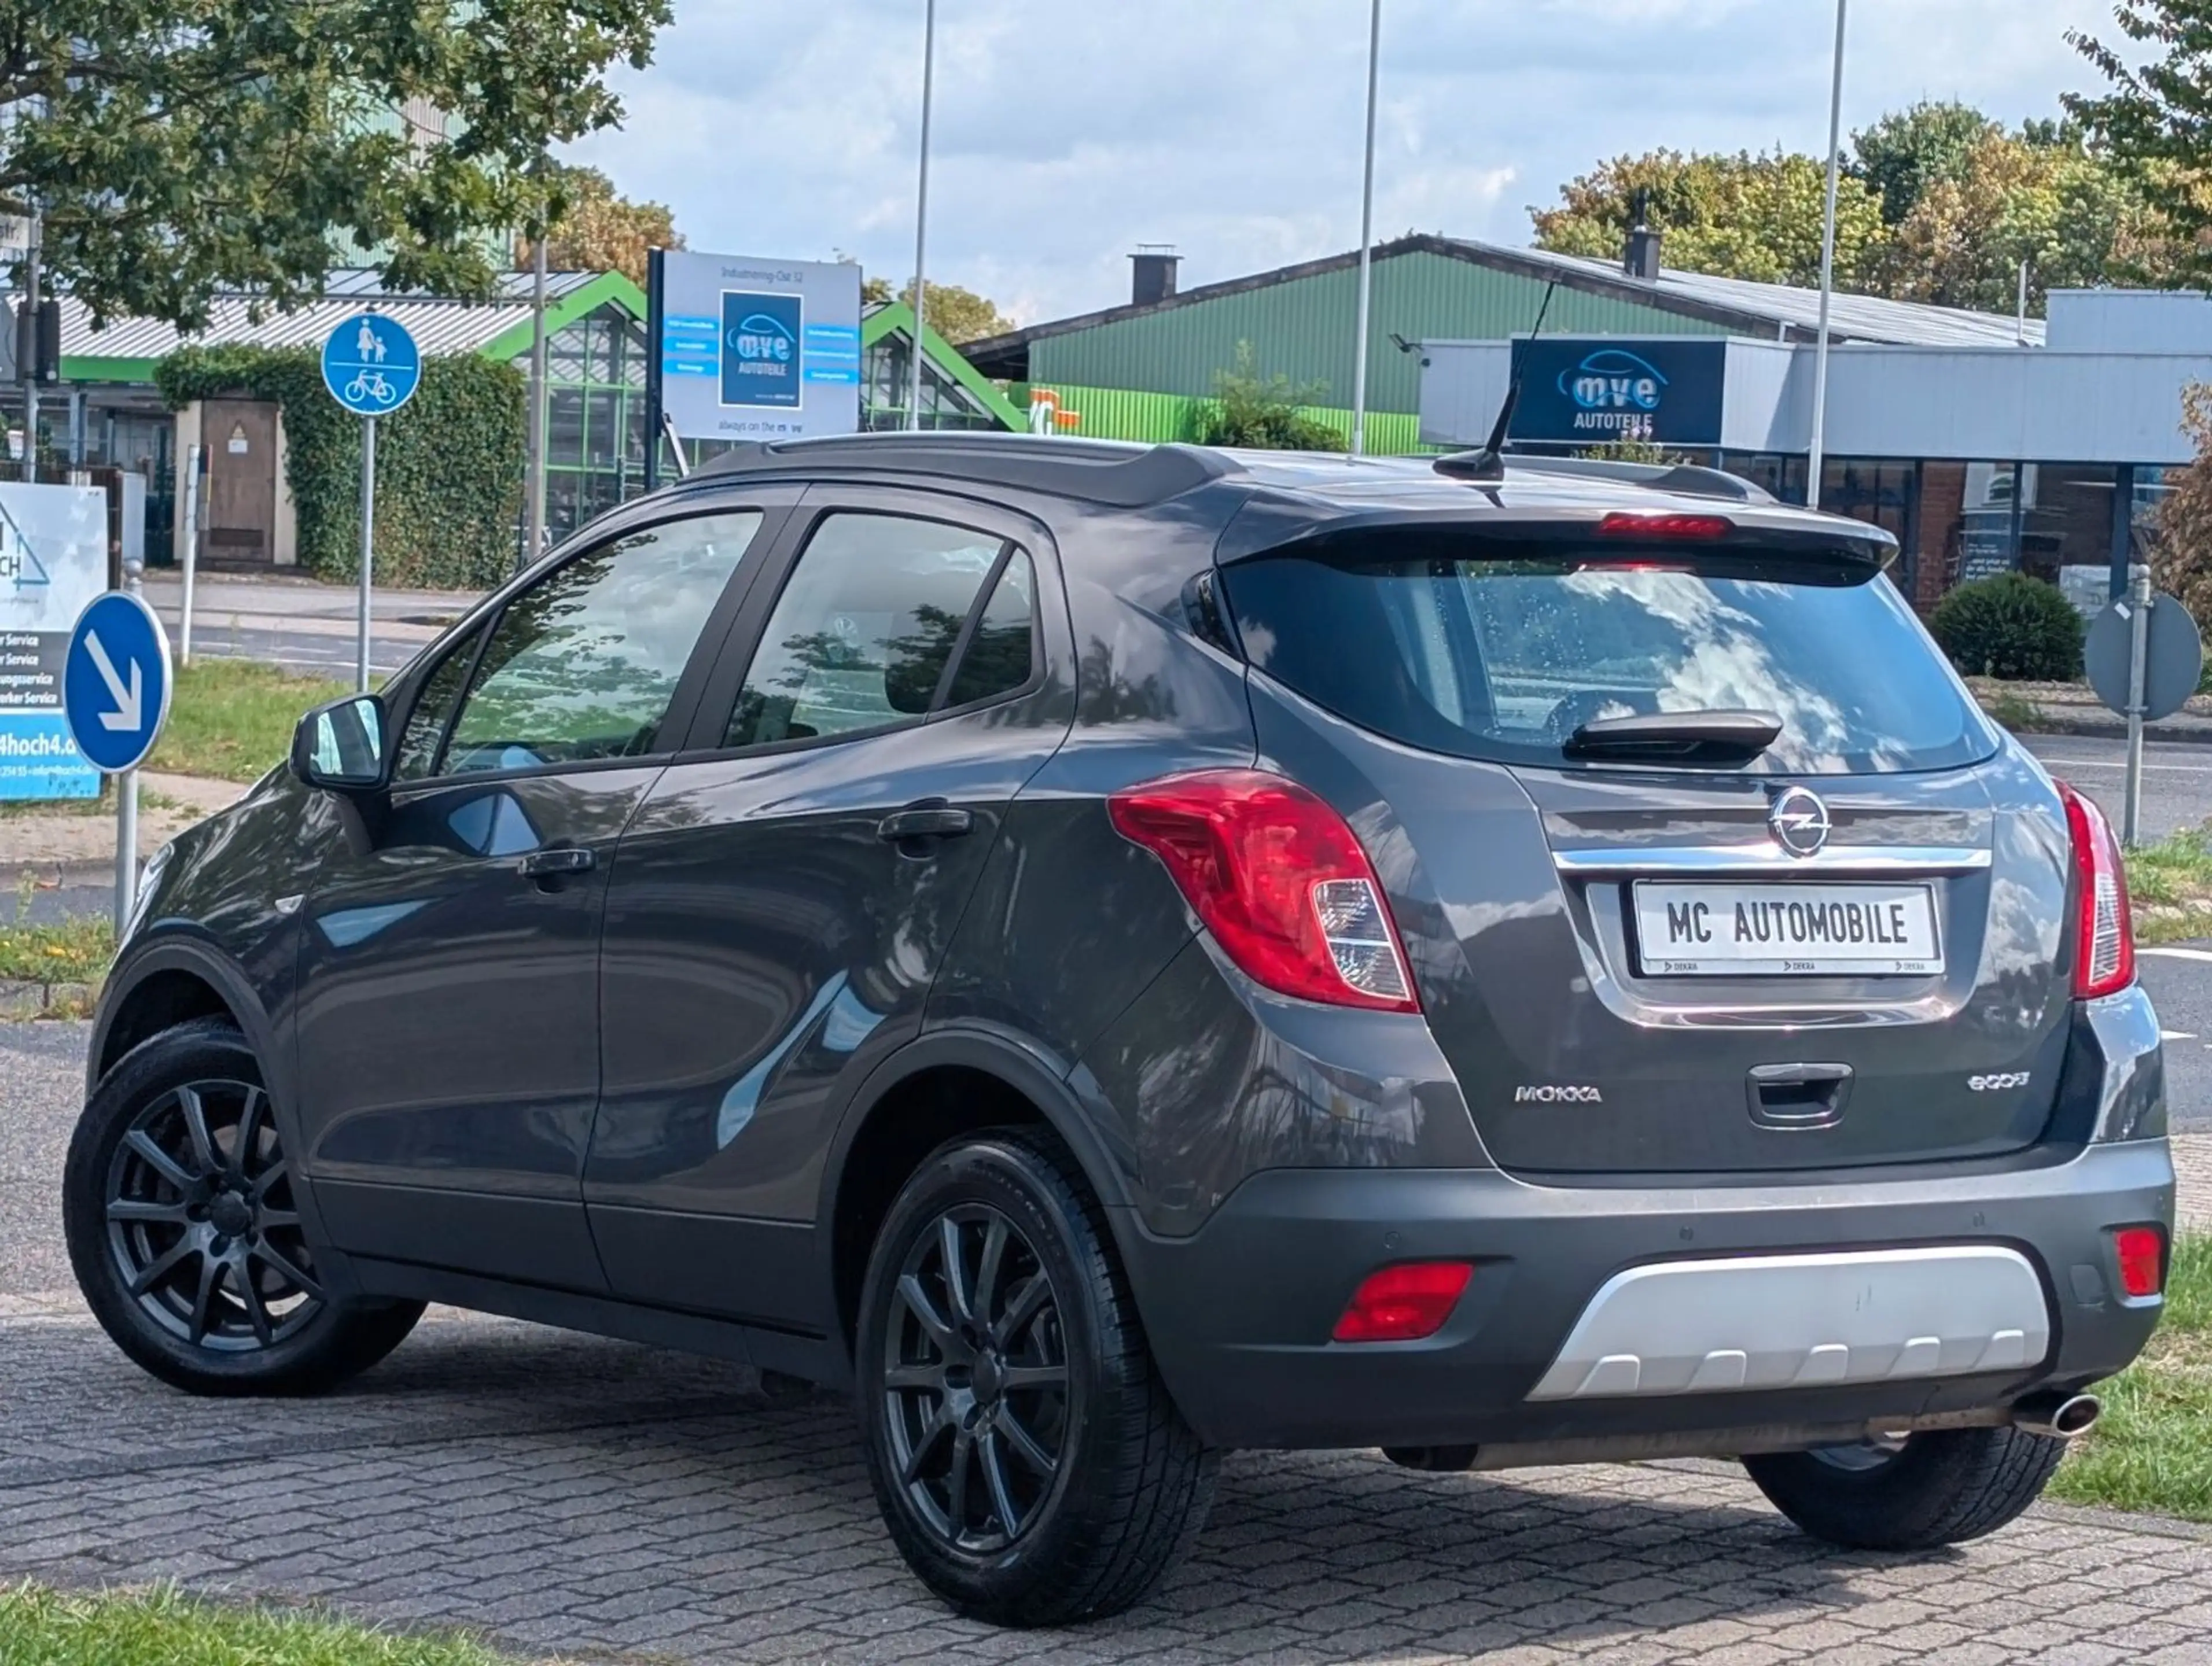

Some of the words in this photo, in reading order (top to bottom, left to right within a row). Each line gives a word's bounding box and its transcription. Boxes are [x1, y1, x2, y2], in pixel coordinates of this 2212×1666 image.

[737, 334, 790, 360] mve
[738, 362, 787, 376] AUTOTEILE
[1574, 377, 1658, 408] mve
[6, 633, 39, 647] Service
[6, 653, 39, 666] Service
[24, 691, 57, 704] Service
[0, 733, 77, 755] 4hoch4.d
[1667, 901, 1712, 943] MC
[1735, 901, 1908, 943] AUTOMOBILE
[1793, 961, 1816, 971] DEKRA
[1515, 1085, 1604, 1103] MOKKA
